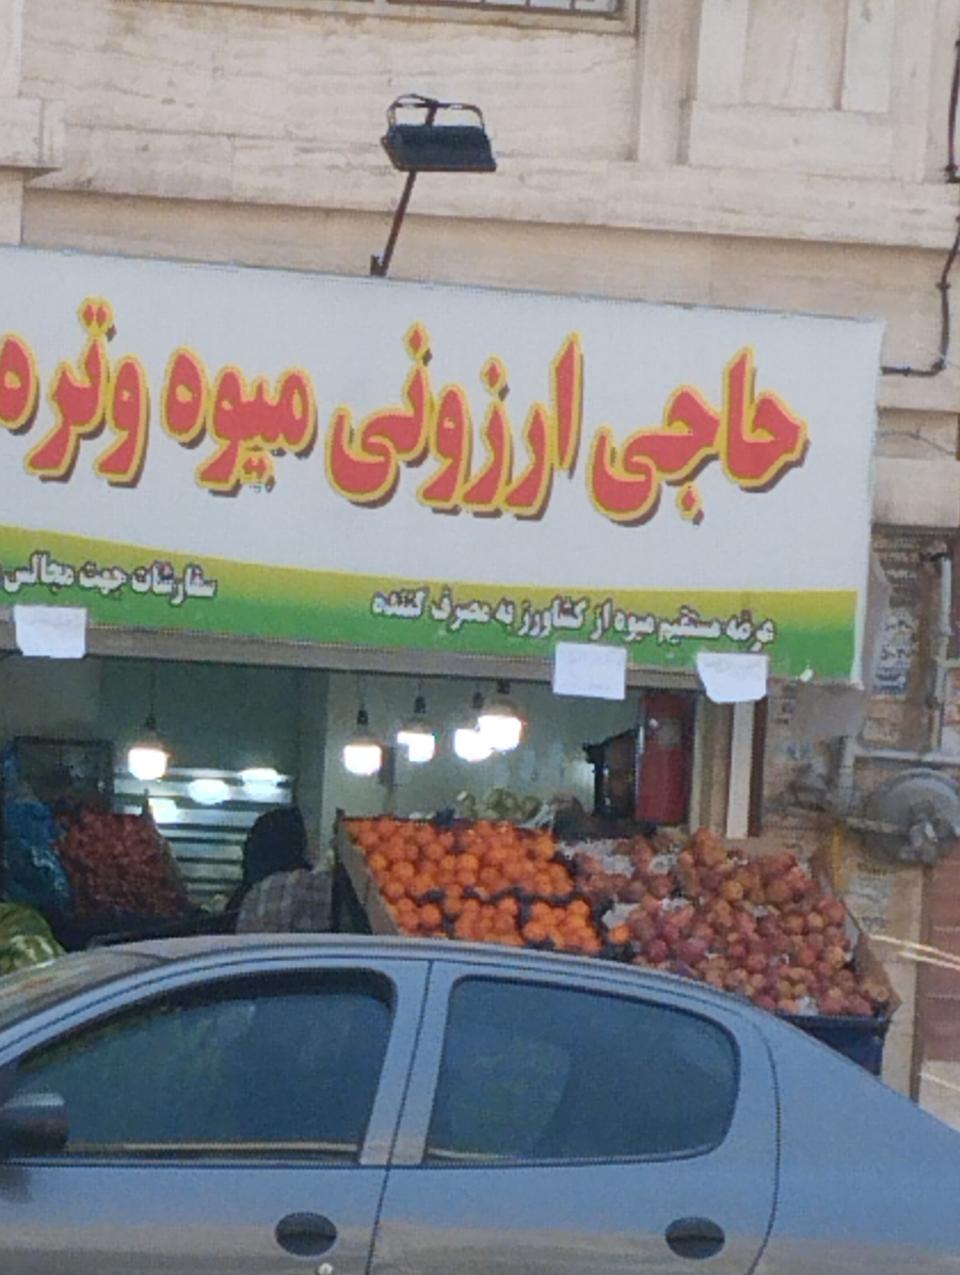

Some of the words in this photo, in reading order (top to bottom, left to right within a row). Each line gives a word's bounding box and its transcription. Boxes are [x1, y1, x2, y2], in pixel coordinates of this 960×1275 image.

[161, 345, 317, 496] میوه
[325, 322, 583, 519] ارزونی
[586, 346, 808, 525] حاجی
[3, 550, 74, 594] مجالس
[79, 561, 128, 599] جهت
[131, 560, 217, 606] سفارشات
